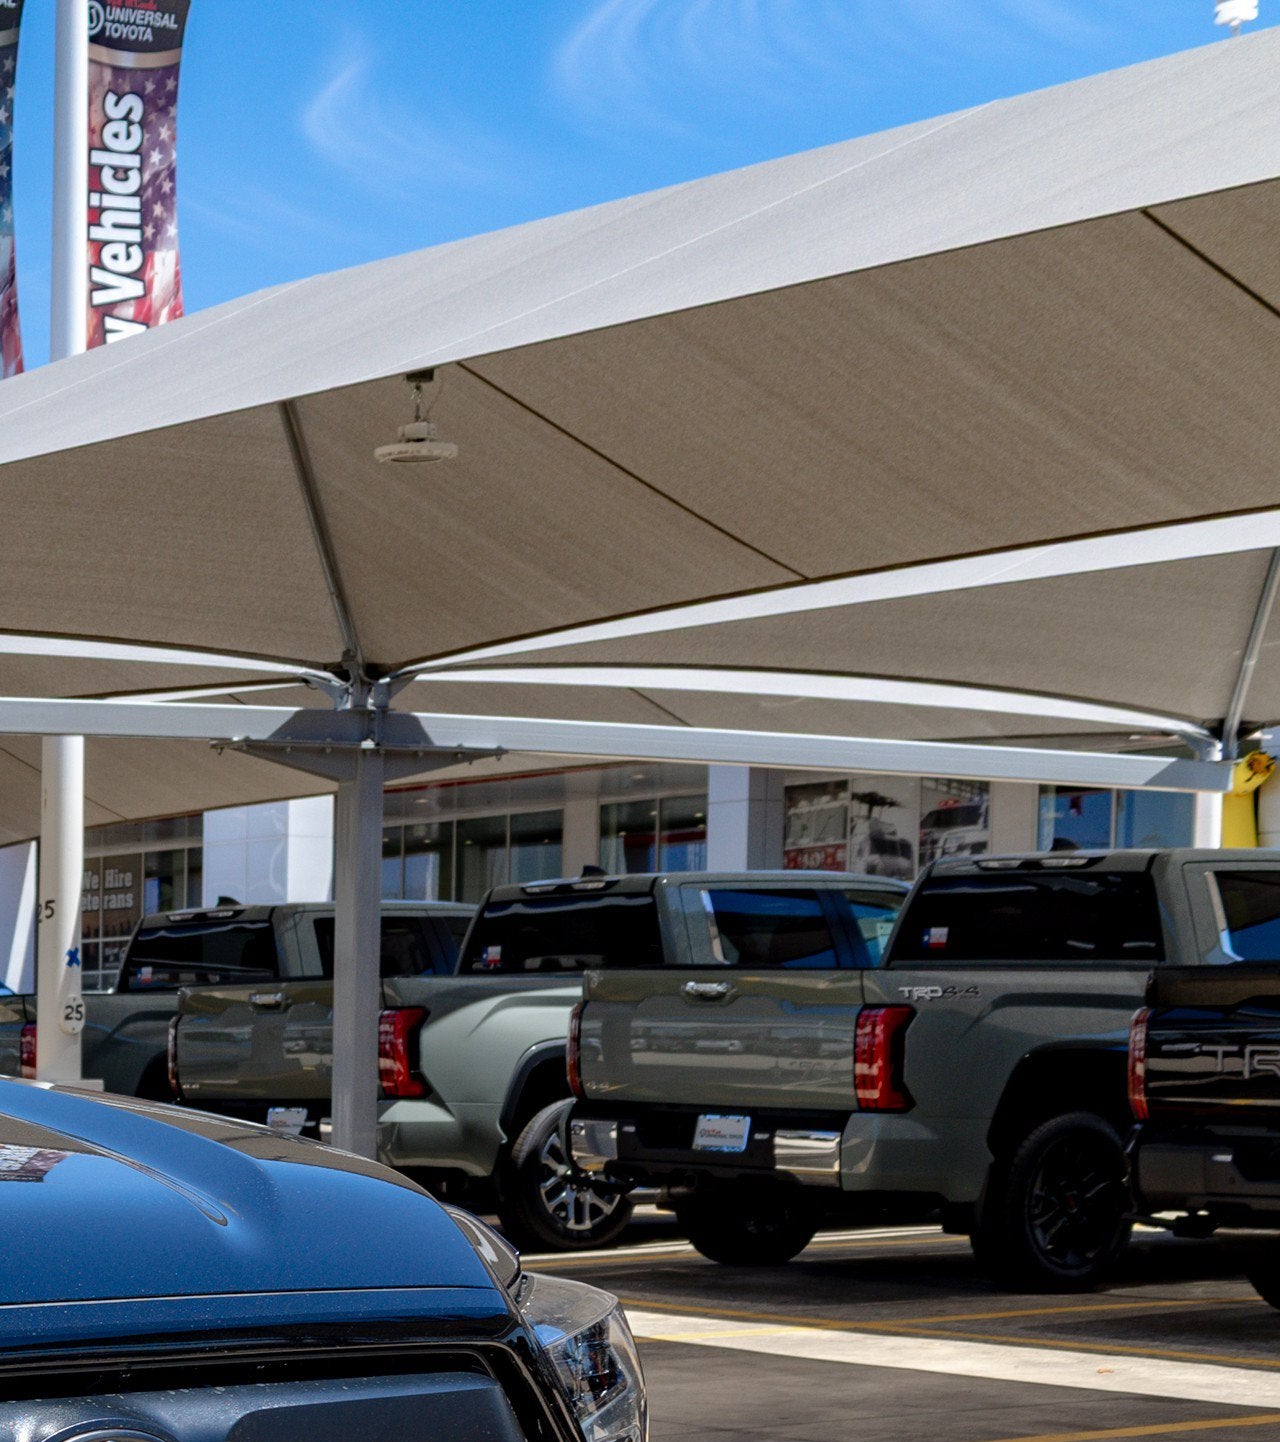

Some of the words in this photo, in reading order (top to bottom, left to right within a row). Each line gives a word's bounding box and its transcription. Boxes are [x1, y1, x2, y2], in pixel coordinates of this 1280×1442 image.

[105, 5, 178, 29] UNIVERSAL
[104, 22, 154, 42] TOYOTA
[88, 92, 146, 307] Vehicles
[104, 869, 132, 889] Hire
[81, 892, 134, 912] eterans
[64, 1004, 84, 1021] 25
